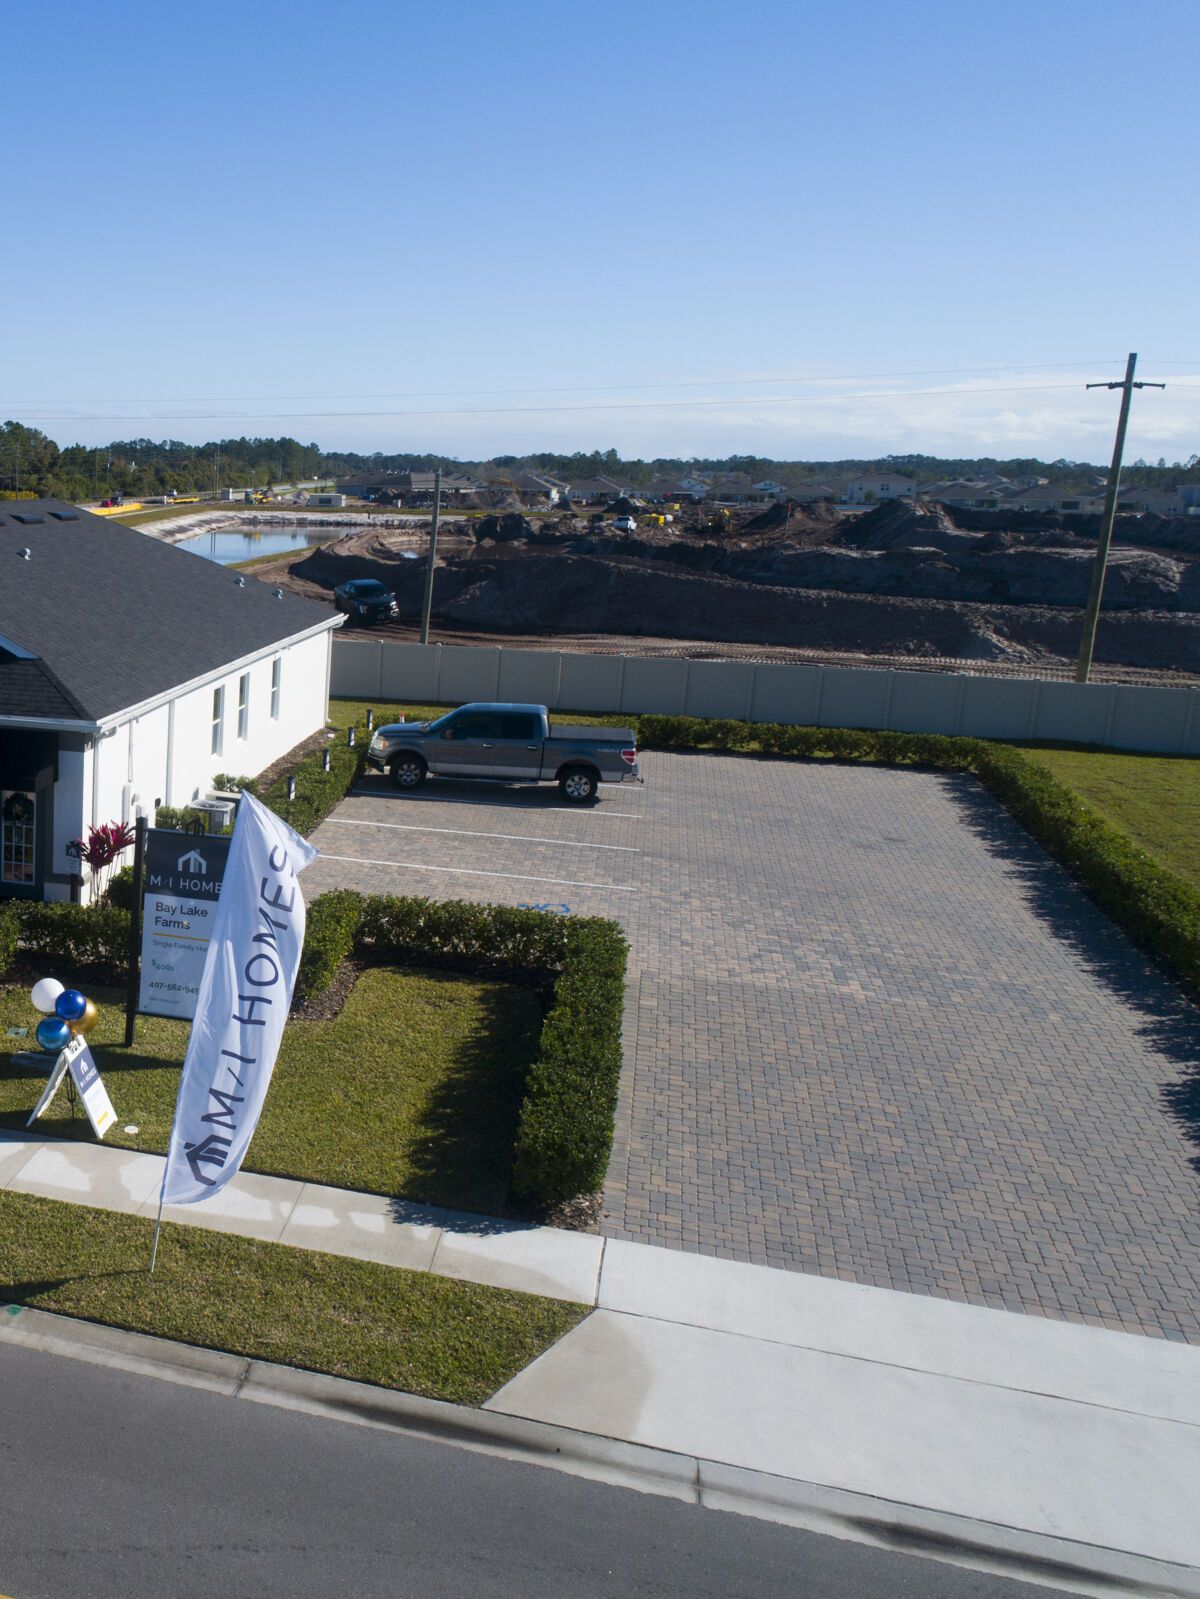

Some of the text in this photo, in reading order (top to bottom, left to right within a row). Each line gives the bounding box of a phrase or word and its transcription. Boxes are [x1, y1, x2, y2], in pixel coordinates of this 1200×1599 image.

[180, 878, 223, 894] HOME
[155, 901, 208, 918] Bay Lake
[154, 915, 191, 930] Farms
[173, 942, 195, 952] Family
[148, 981, 200, 995] 407-562-949
[200, 844, 296, 1130] M/I HOMES
